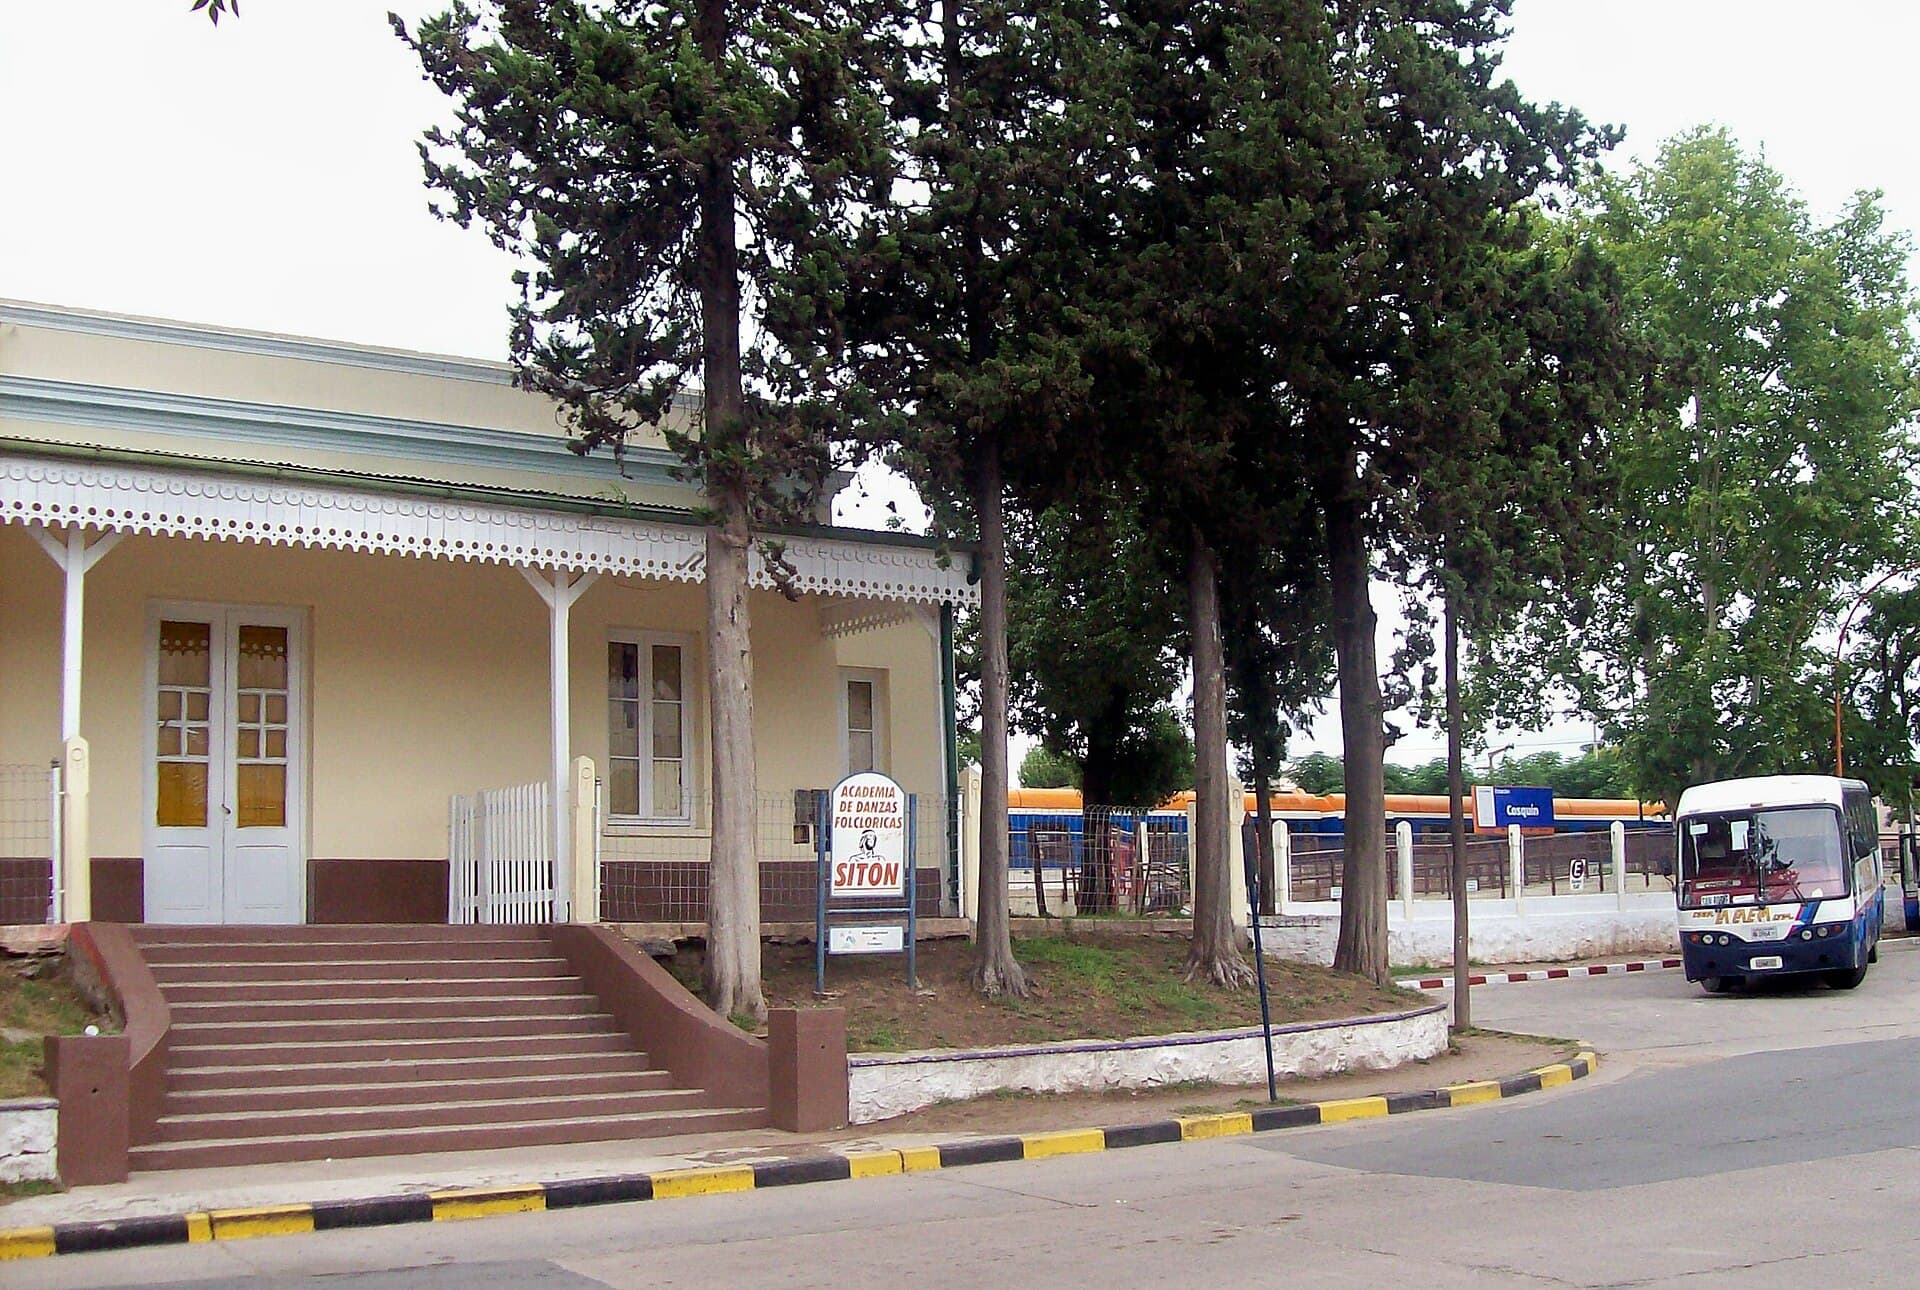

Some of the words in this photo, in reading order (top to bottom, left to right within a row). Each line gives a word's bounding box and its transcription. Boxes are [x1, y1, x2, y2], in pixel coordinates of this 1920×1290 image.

[841, 785, 896, 798] ACADEMIA
[839, 801, 853, 813] DE
[856, 801, 898, 813] DANZAS
[834, 816, 903, 829] FOLCLORICAS
[834, 862, 900, 887] SITON
